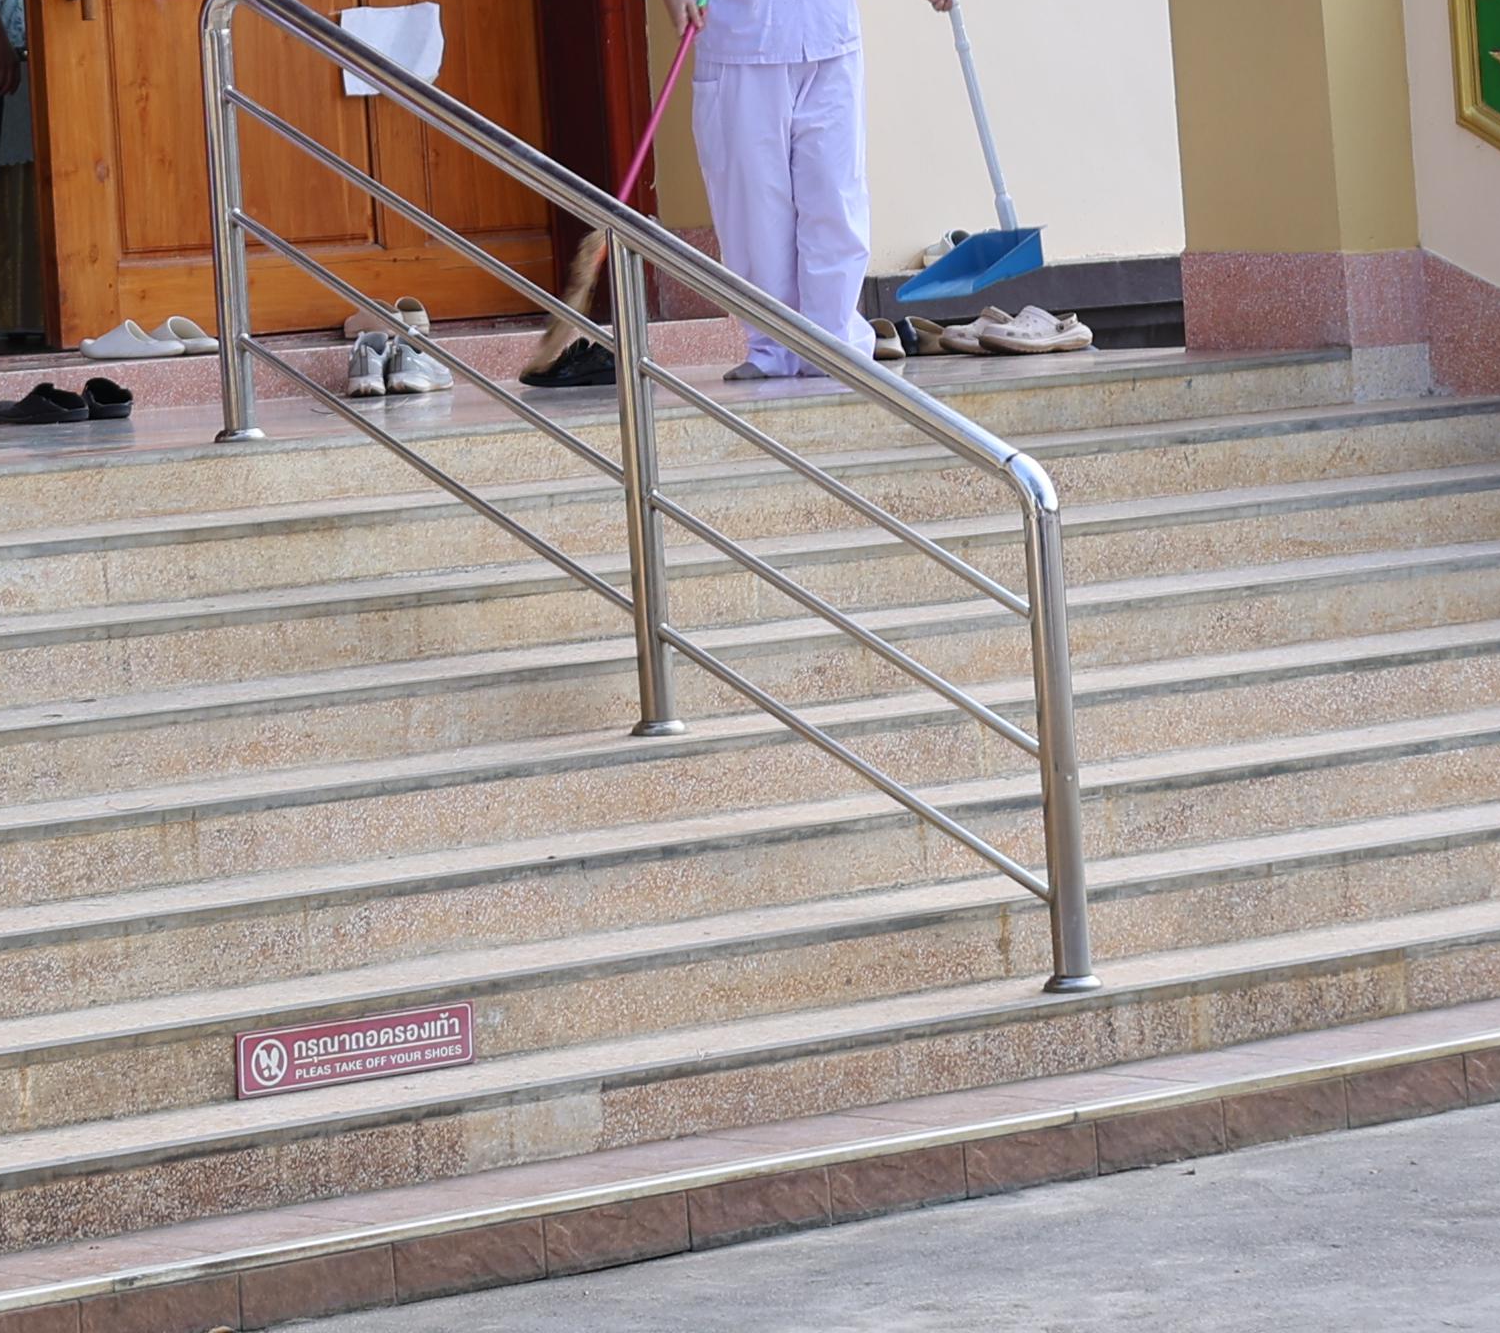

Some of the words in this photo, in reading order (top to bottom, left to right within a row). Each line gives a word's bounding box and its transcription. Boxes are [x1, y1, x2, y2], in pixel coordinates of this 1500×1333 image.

[294, 1011, 460, 1063] กรุณาถอดรองเท้า
[295, 1064, 332, 1080] PLEAS
[335, 1059, 363, 1074] TAKE
[366, 1056, 388, 1070] OFF
[390, 1051, 422, 1065] YOUR
[424, 1044, 463, 1060] SHOES
